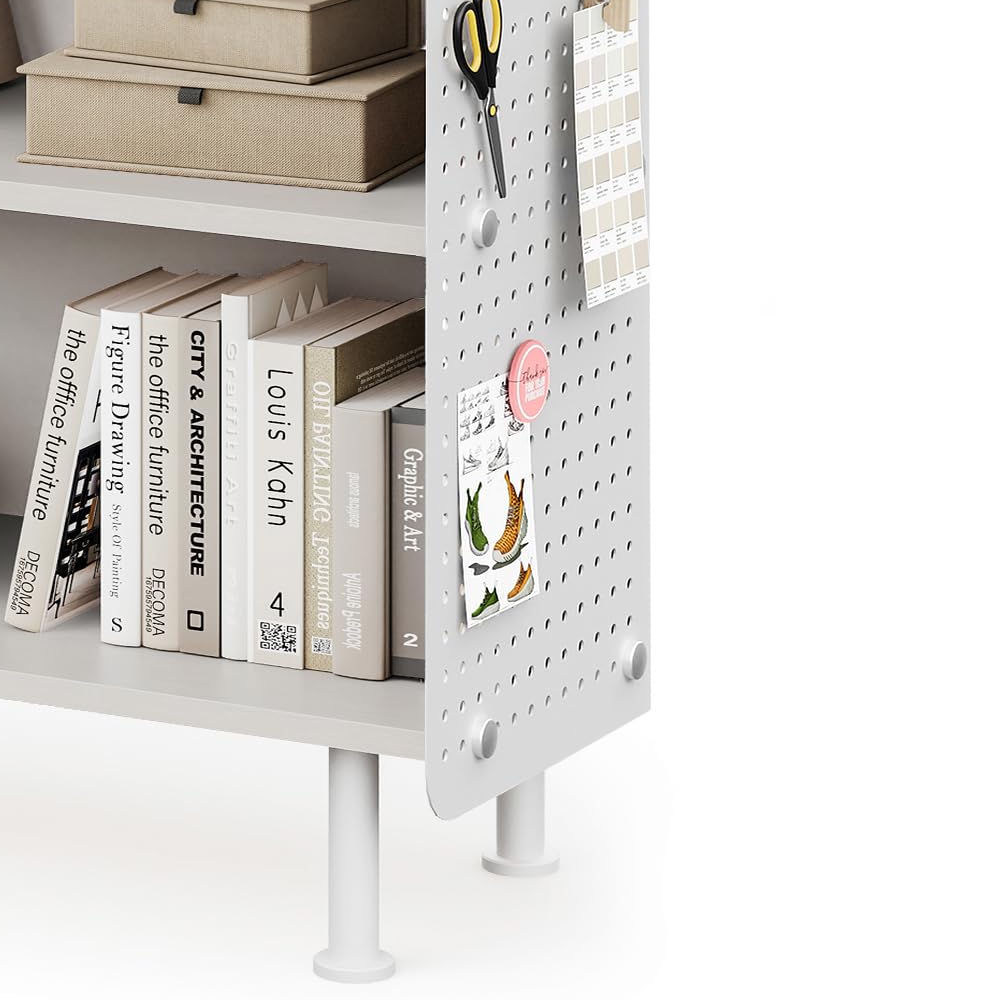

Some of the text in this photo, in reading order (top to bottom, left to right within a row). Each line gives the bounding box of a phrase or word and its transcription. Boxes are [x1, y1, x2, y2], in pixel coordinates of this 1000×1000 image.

[63, 328, 86, 362] the
[149, 334, 169, 368] the
[106, 325, 130, 494] Figure Drawing
[267, 369, 294, 526] Louis Kahn
[32, 434, 67, 521] furniture
[149, 446, 169, 536] furniture
[190, 330, 205, 576] CITY & ARCHITECTURE
[398, 448, 424, 552] Graphic & Art
[16, 550, 40, 615] DECOMA
[109, 504, 122, 598] Style Of Painting
[112, 616, 122, 632] S
[152, 568, 165, 636] DECOMA
[270, 592, 285, 618] 4
[403, 633, 418, 648] 2
